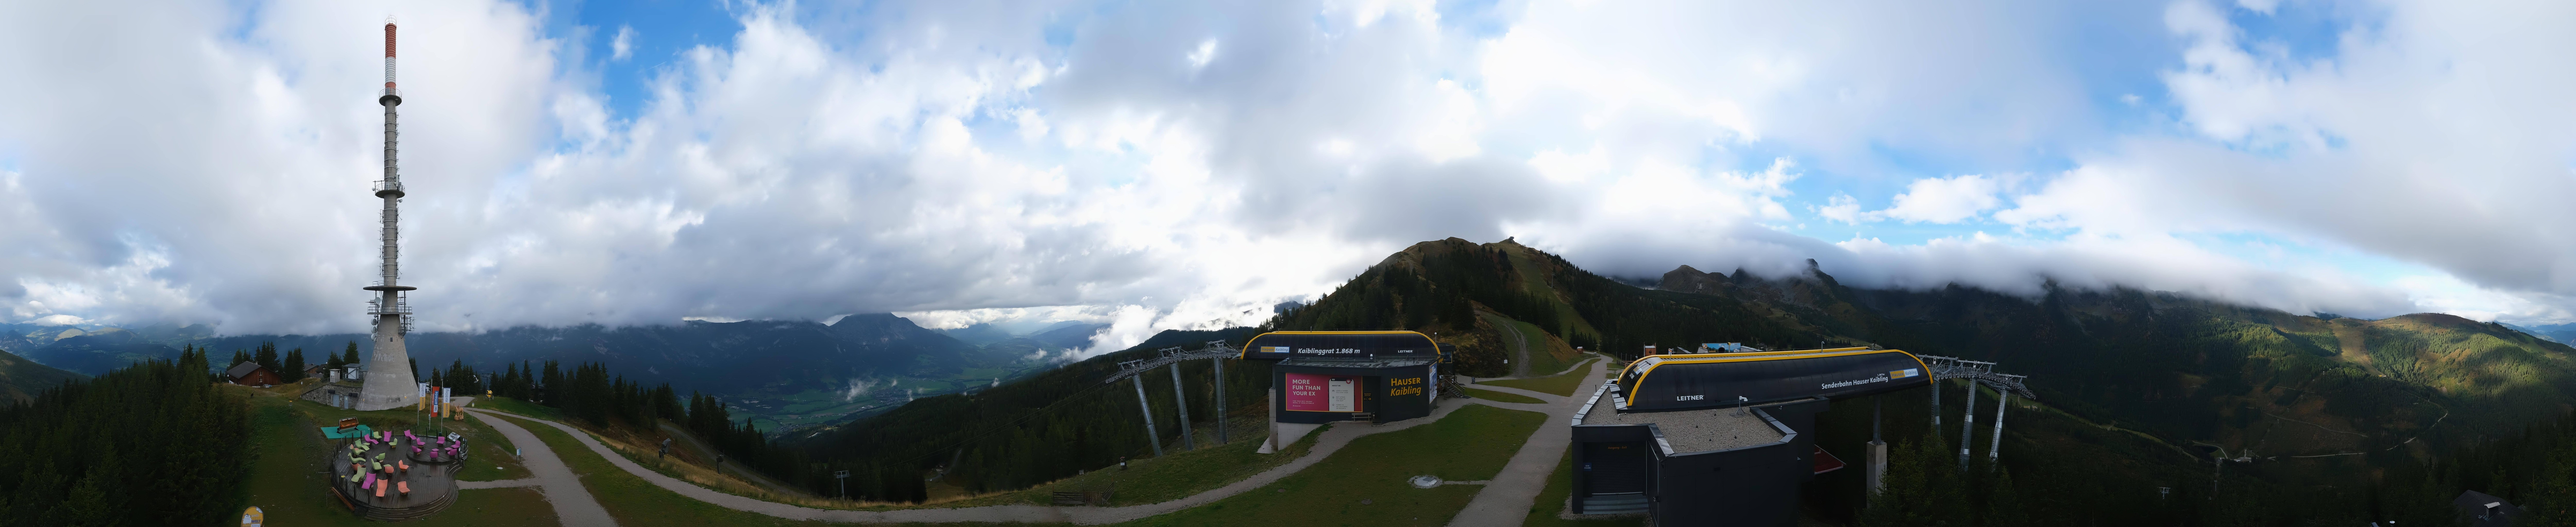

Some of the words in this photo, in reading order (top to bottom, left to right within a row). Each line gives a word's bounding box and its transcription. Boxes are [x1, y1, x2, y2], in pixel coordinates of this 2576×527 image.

[1391, 378, 1421, 386] HAUSER
[1822, 380, 1852, 389] Senderbahn
[1391, 386, 1421, 396] Kaibling
